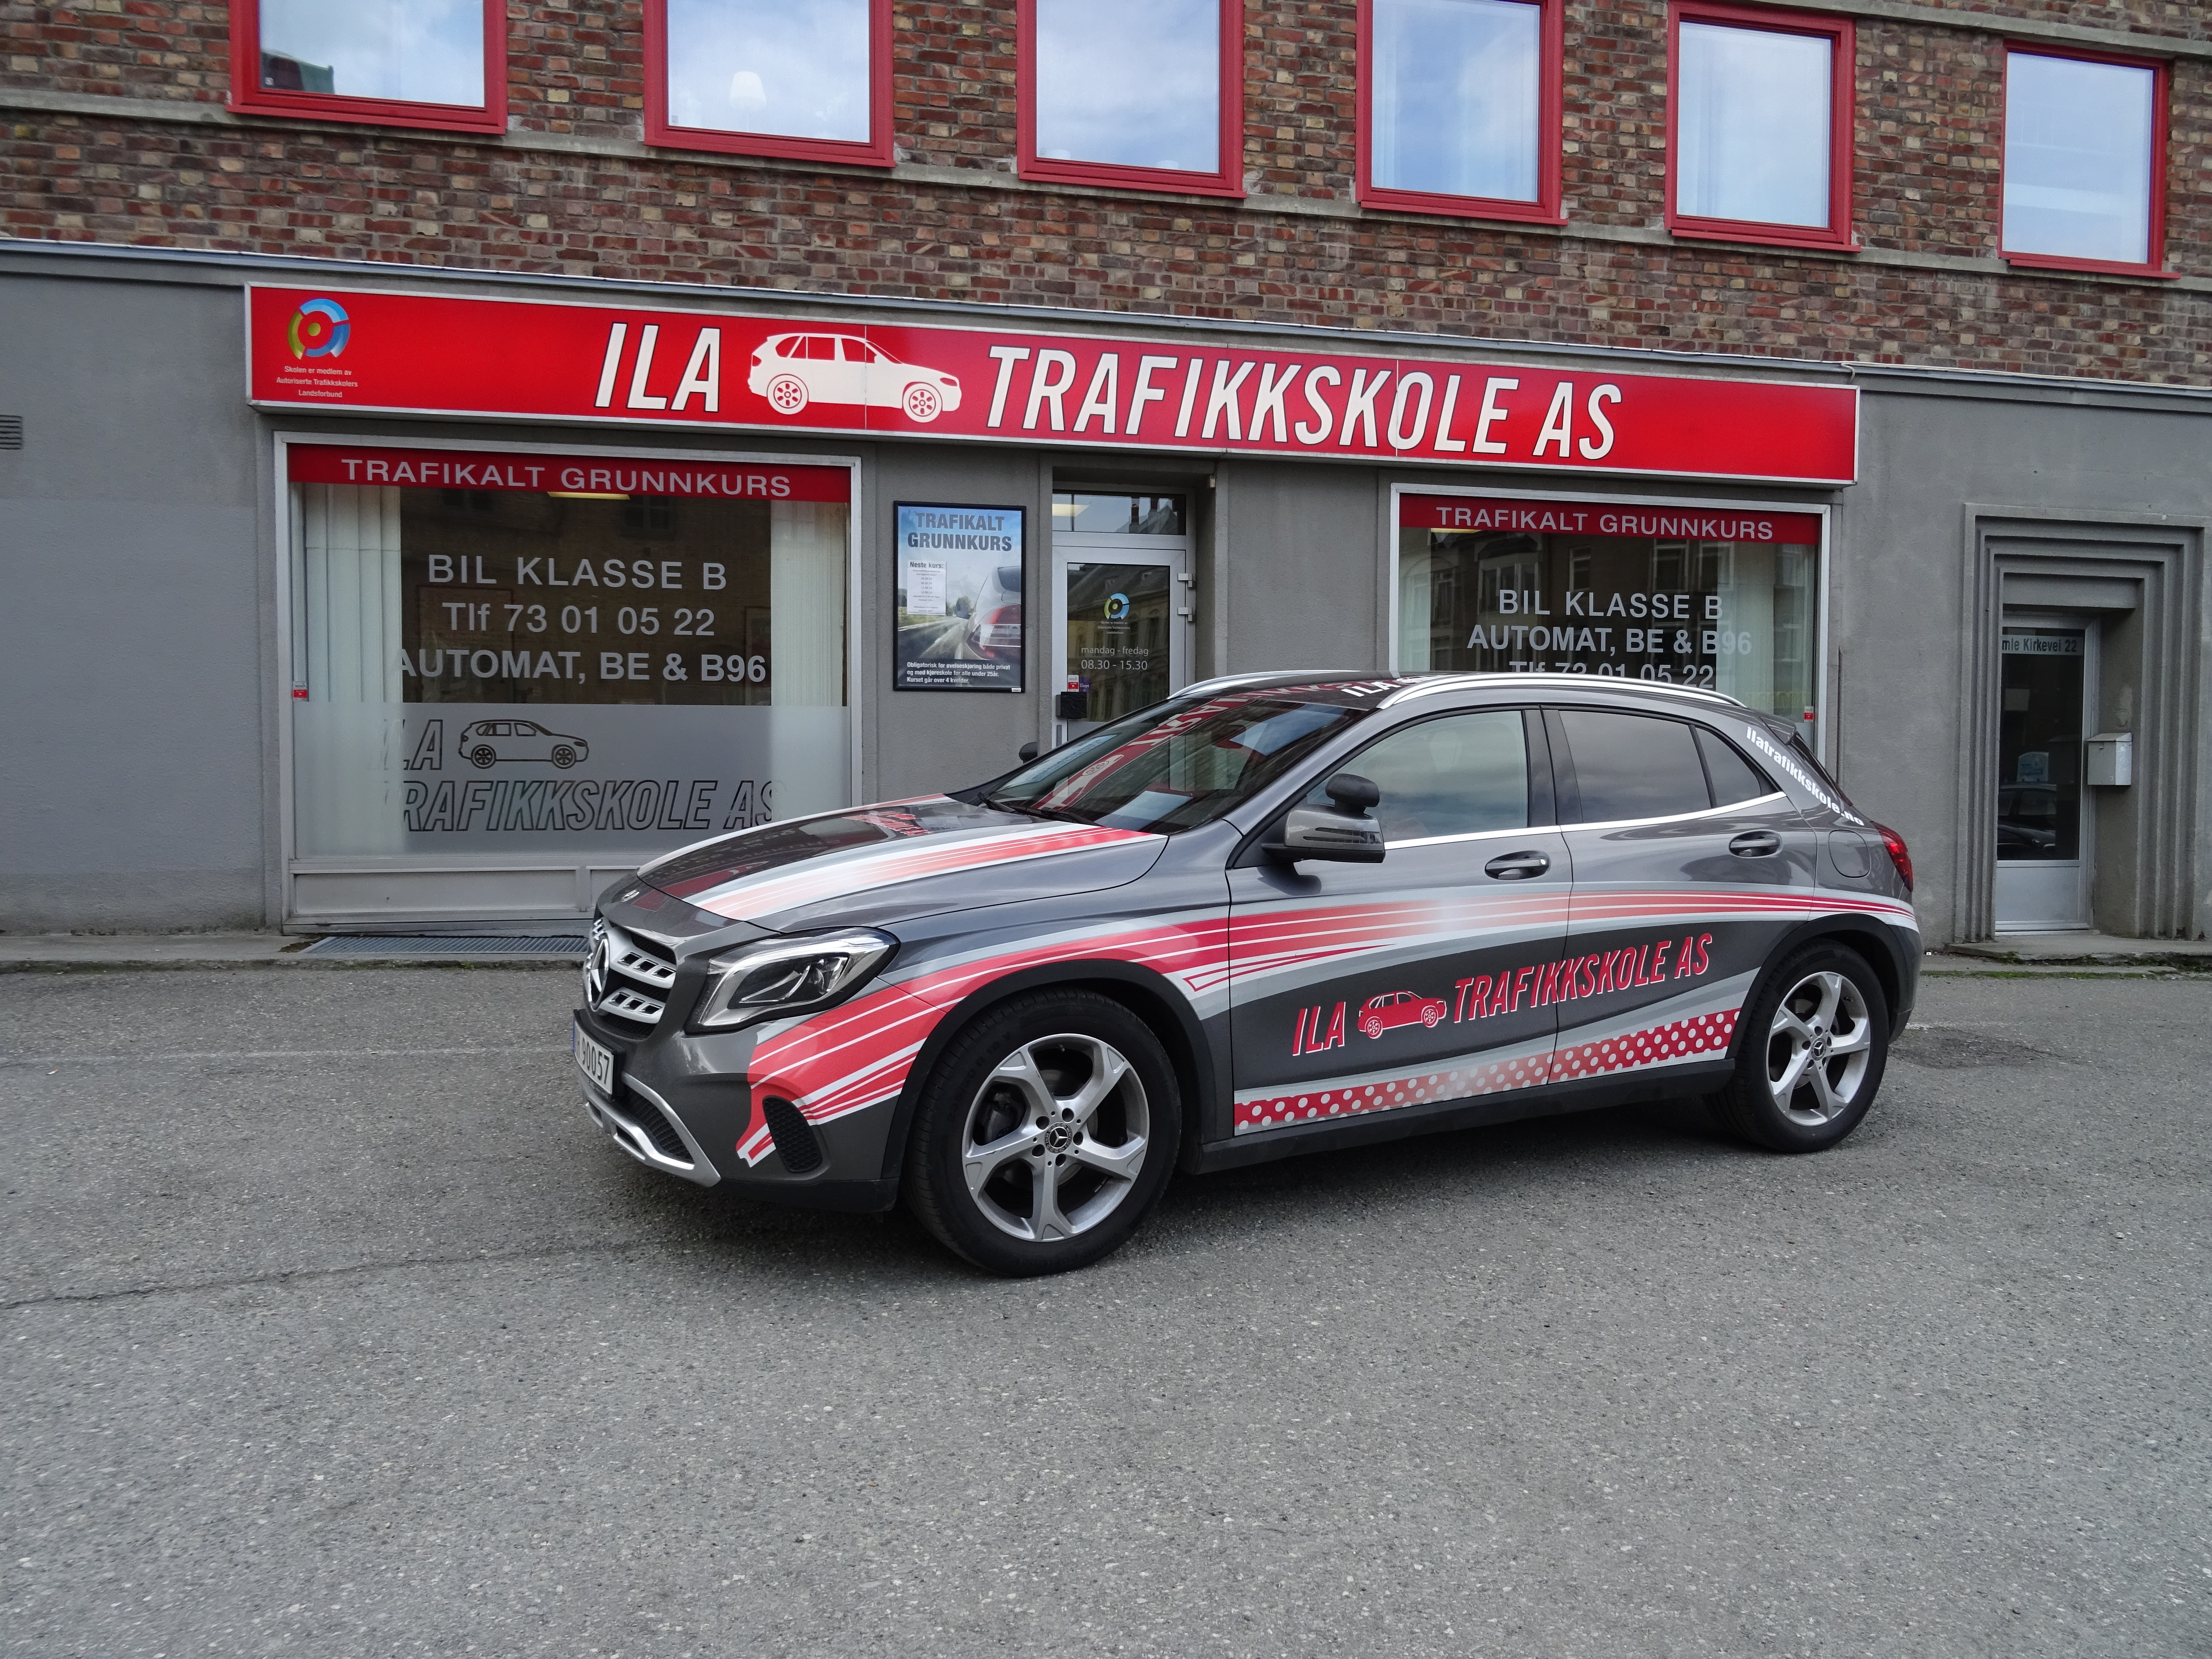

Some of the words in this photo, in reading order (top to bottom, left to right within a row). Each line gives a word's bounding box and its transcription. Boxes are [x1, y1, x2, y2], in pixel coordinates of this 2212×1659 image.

[298, 389, 343, 398] Landsforbund
[313, 378, 358, 387] Trafikkskolers
[594, 323, 720, 413] ILA
[987, 346, 1519, 454] TRAFIKKSKOLE
[1532, 382, 1621, 460] AS
[341, 459, 545, 488] TRAFIKALT
[561, 468, 790, 498] GRUNNKURS
[914, 512, 1005, 532] TRAFIKALT
[1436, 506, 1588, 532] TRAFIKALT
[1599, 514, 1773, 540] GRUNNKURS
[907, 532, 1012, 552] GRUNNKURS
[429, 554, 497, 584] BIL
[518, 557, 682, 589] KLASSE
[703, 562, 727, 590] B
[442, 602, 491, 631] Tlf
[504, 604, 547, 632] 73
[561, 605, 597, 633] 01
[618, 607, 660, 635] 05
[674, 608, 715, 636] 22
[1499, 589, 1550, 615] BIL
[1566, 591, 1690, 619] KLASSE
[1705, 595, 1723, 619] B
[1081, 646, 1115, 656] mandag
[1122, 646, 1149, 657] fredag
[1467, 624, 1615, 657] AUTOMAT,
[1626, 628, 1664, 653] BE
[1673, 629, 1693, 654] &
[1702, 630, 1752, 655] B96
[2002, 638, 2020, 651] mle
[2023, 638, 2061, 652] Kirkevei
[2064, 640, 2077, 653] 22
[398, 649, 585, 684] AUTOMAT,
[600, 652, 650, 680] BE
[663, 653, 688, 681] &
[701, 654, 766, 683] B96
[1081, 659, 1110, 669] 08.30
[1120, 660, 1148, 670] 15.30
[1640, 664, 1672, 683] 05
[1682, 664, 1714, 688] 22
[1341, 681, 1401, 697] ILA
[1746, 726, 1865, 826] ilatrafikkskole.no
[403, 780, 718, 832] RAFIKKSKOLE
[1292, 1001, 1346, 1056] ILA
[1452, 940, 1671, 1023] TRAFIKKSKOLE
[1674, 933, 1712, 978] AS
[577, 1028, 610, 1085] 90057
